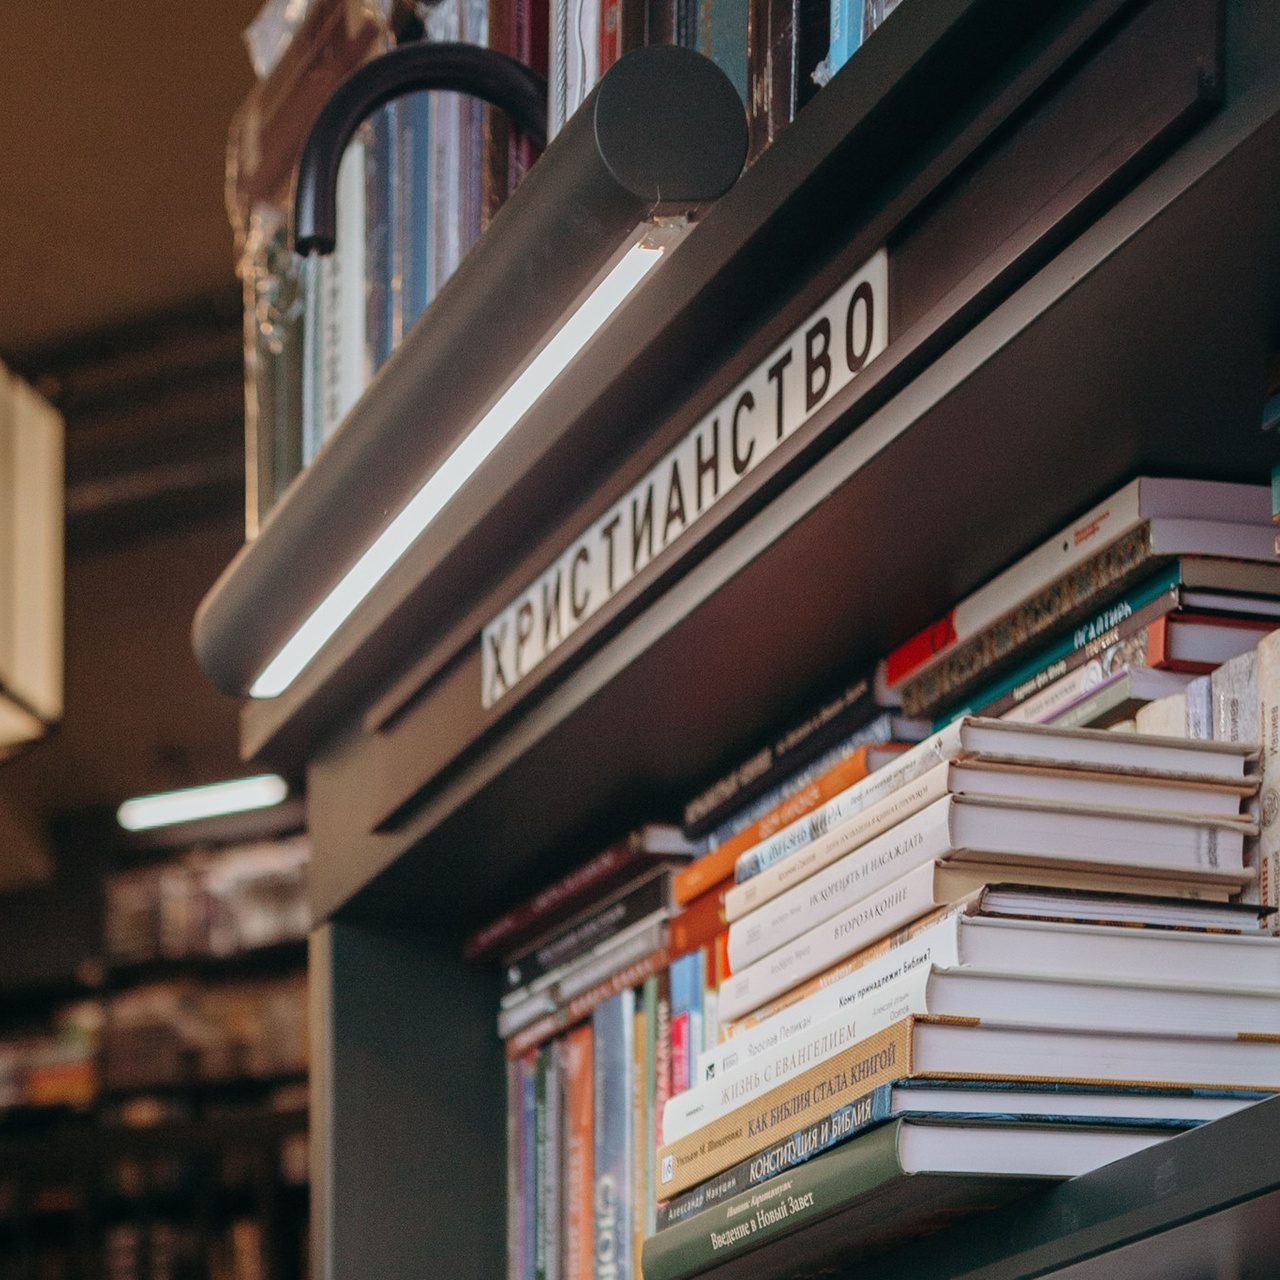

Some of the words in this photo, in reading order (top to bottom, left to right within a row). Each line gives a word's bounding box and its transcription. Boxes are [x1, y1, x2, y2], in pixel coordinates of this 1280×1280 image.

[487, 271, 875, 700] ХРИСТИАНСТВО
[862, 862, 868, 876] И
[871, 828, 923, 873] НАСАЖДАТЬ
[833, 886, 907, 942] ВТОРОЗАКОНИЕ
[839, 988, 856, 1009] Кому
[858, 962, 902, 999] принадлежит
[905, 946, 932, 972] Библия?
[747, 1029, 777, 1058] Ярослав
[779, 1010, 811, 1040] Пеликан
[871, 998, 892, 1018] Алексей
[889, 1000, 910, 1021] Осипов
[720, 1069, 760, 1106] ЖИЗНЬ
[764, 1064, 771, 1082] С
[775, 1020, 856, 1078] ЕВАНГЕЛИЕМ
[748, 1110, 767, 1138] КАК
[770, 1088, 809, 1127] БИБЛИЯ
[813, 1069, 846, 1104] СТАЛА
[850, 1039, 895, 1086] КНИГОЙ
[749, 1129, 817, 1183] КОНСТИТУЦИЯ
[821, 1122, 828, 1144] И
[832, 1097, 871, 1139] БИБЛИЯ
[668, 1192, 703, 1221] Александр
[710, 1216, 749, 1253] Введение
[751, 1216, 756, 1232] в
[756, 1197, 787, 1229] Новый
[788, 1185, 814, 1214] Завет
